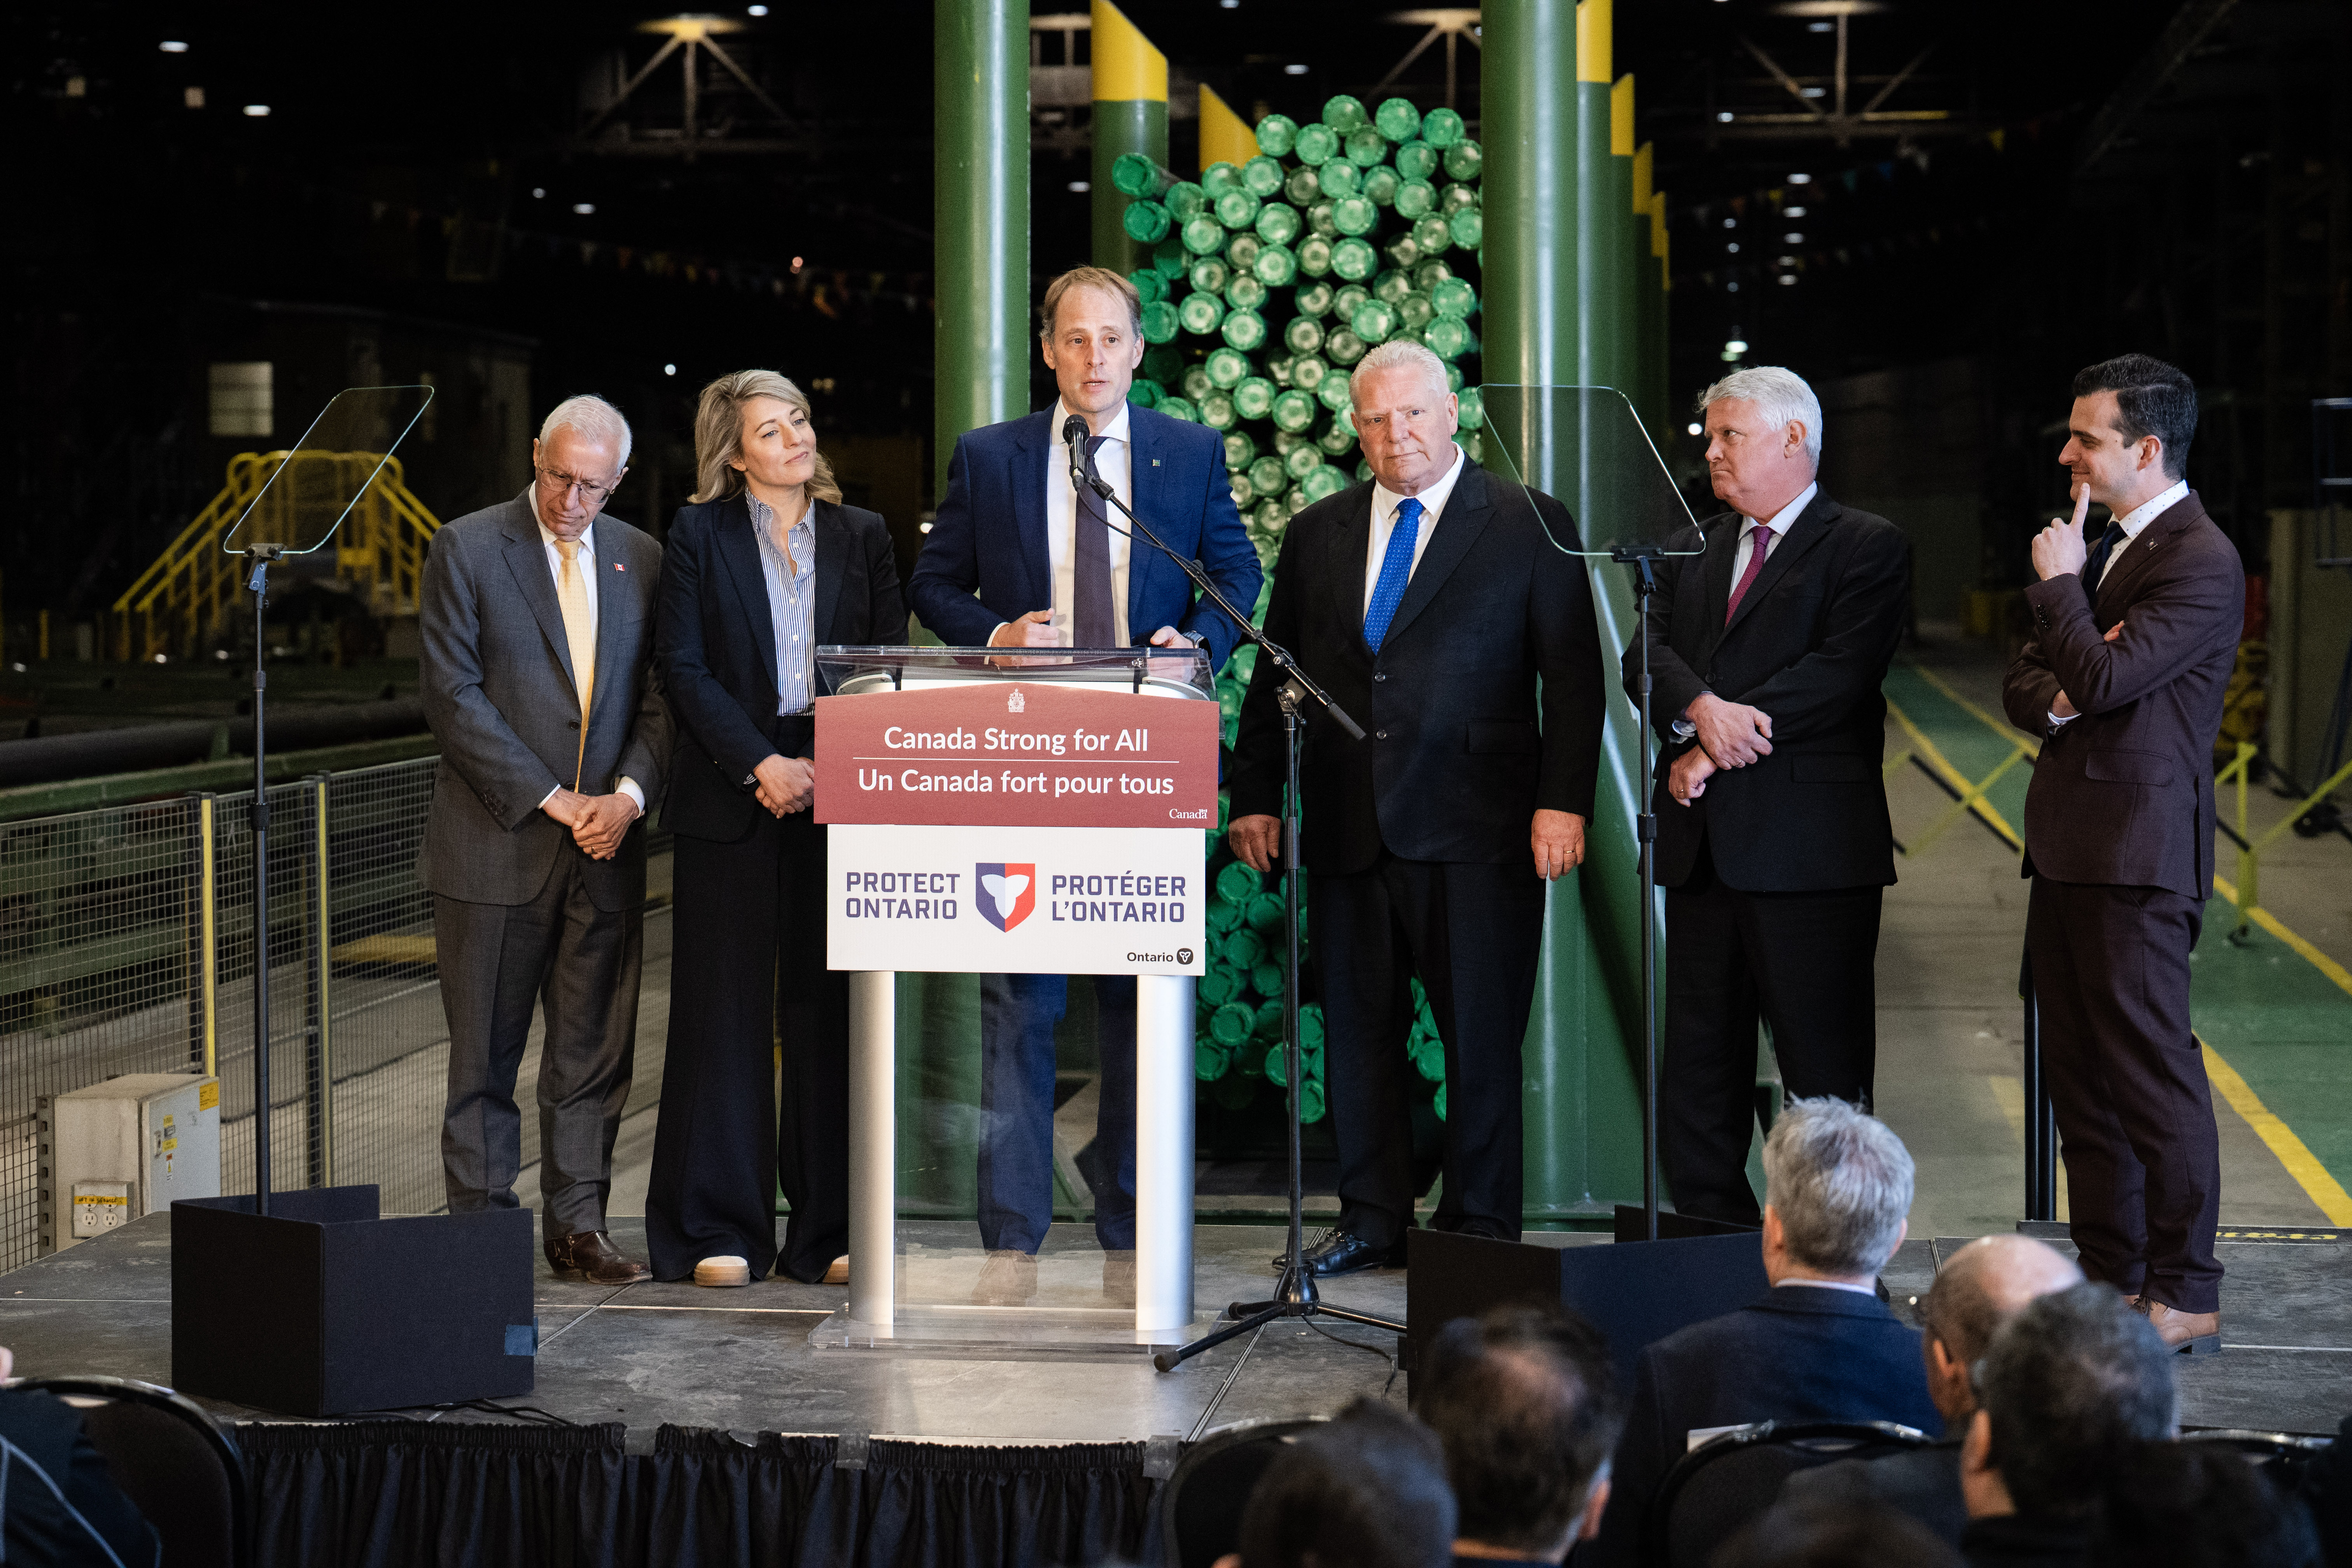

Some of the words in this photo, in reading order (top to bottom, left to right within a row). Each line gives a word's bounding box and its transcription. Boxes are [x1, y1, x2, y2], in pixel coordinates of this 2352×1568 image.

[884, 726, 976, 749] Canada
[984, 728, 1066, 755] Strong
[1073, 728, 1110, 751] for
[1115, 729, 1148, 751] All
[859, 768, 892, 791] Un
[901, 769, 992, 792] Canada
[1000, 770, 1047, 793] fort
[1055, 777, 1113, 798] pour
[1119, 773, 1174, 794] tous
[1169, 808, 1208, 819] Canada
[847, 872, 960, 893] PROTECT
[1052, 870, 1186, 896] PROTÉGER
[846, 898, 957, 919] ONTARIO
[1052, 901, 1184, 922] L’ONTARIO
[1127, 952, 1174, 962] Ontario
